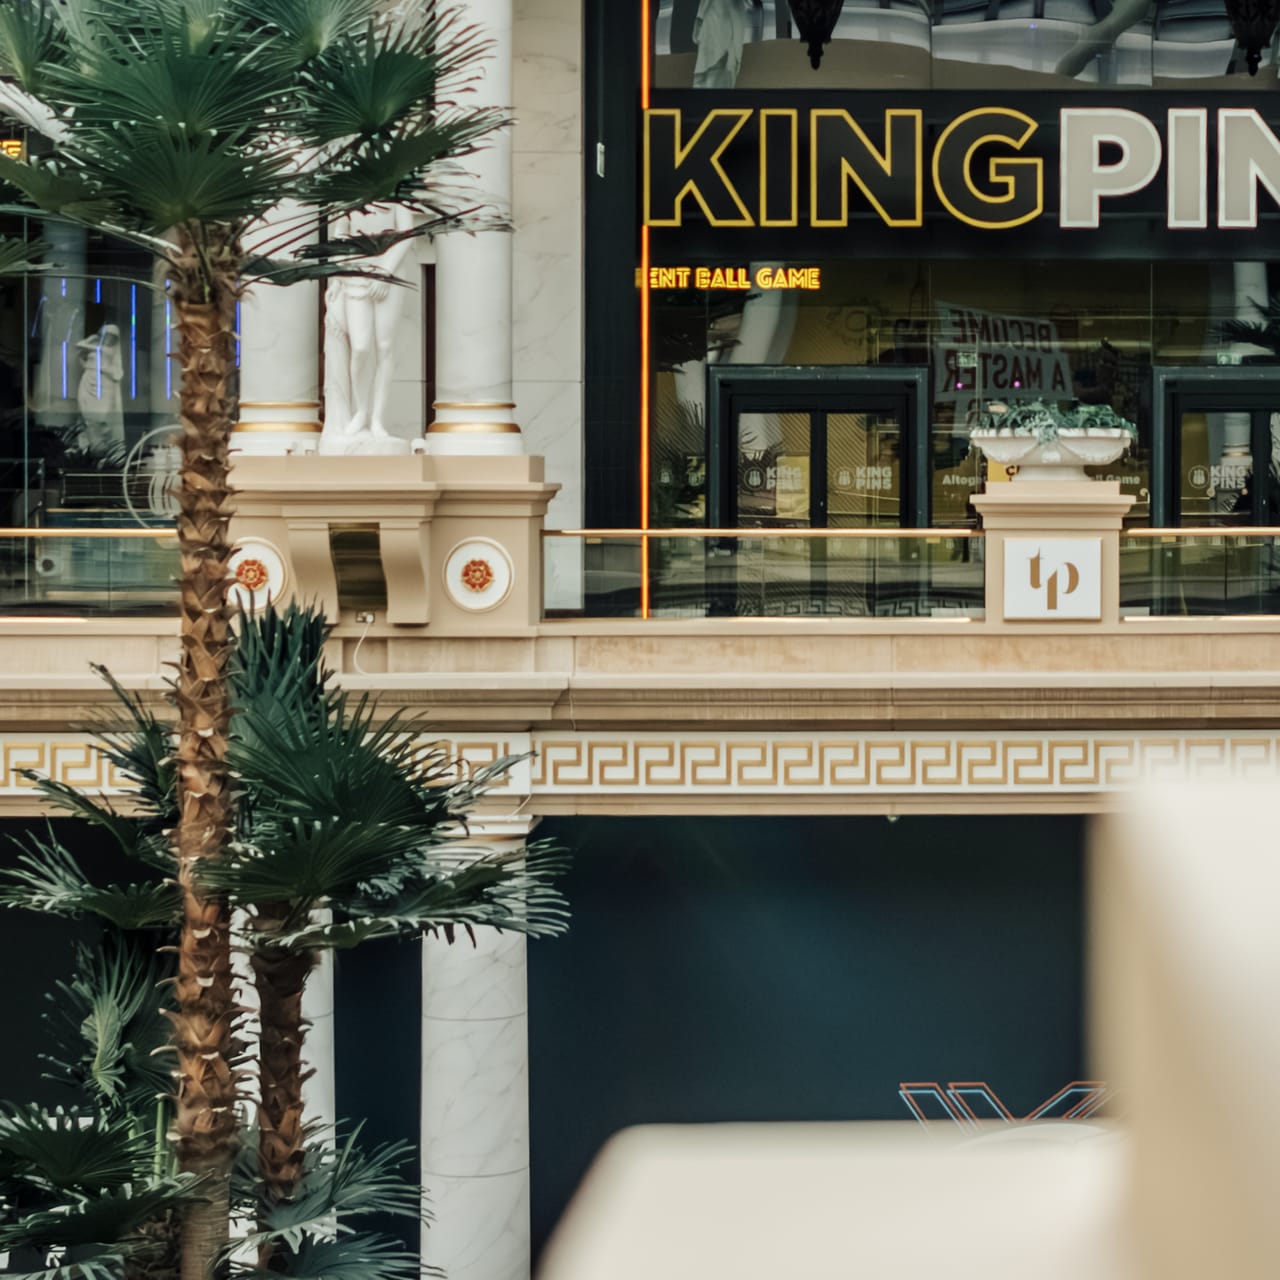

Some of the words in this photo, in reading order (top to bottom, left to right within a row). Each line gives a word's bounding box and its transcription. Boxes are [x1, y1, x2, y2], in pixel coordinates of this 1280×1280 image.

[635, 267, 690, 288] ENT
[696, 267, 751, 289] BALL
[756, 267, 820, 289] GAME
[856, 467, 892, 478] KING
[1210, 466, 1246, 477] KING
[856, 479, 892, 490] PINS
[1210, 478, 1246, 489] PINS
